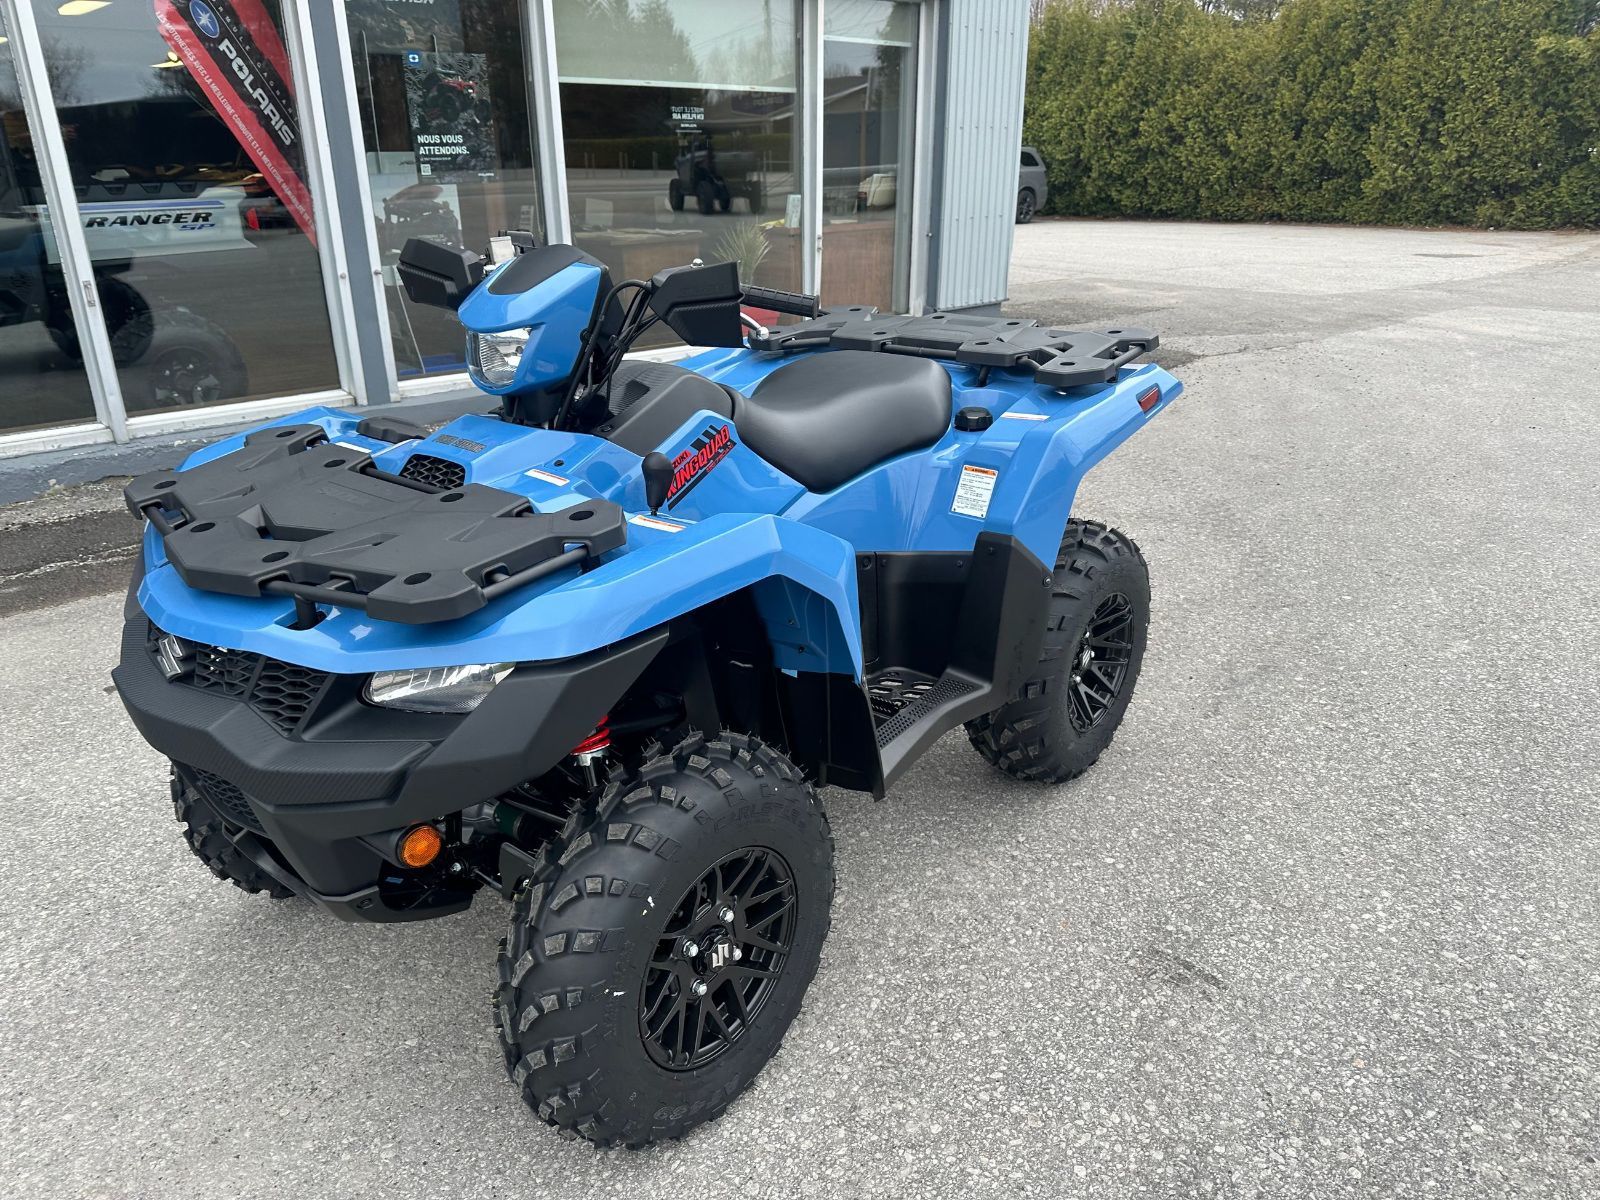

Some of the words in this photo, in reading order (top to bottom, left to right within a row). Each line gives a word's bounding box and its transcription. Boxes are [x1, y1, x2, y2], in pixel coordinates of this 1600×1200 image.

[156, 11, 167, 25] LES
[164, 23, 196, 62] MOTONEIGES
[193, 60, 208, 77] AVEC
[204, 75, 213, 85] LA
[209, 83, 236, 116] MEILLEURE
[232, 114, 254, 143] CONDUITE
[218, 38, 295, 146] POLARIS
[417, 135, 440, 143] NOUS
[441, 135, 463, 143] VOUS
[419, 146, 470, 155] ATTENDONS.
[86, 212, 213, 228] RANGER
[180, 223, 216, 231] SP
[672, 449, 692, 469] ZUKI
